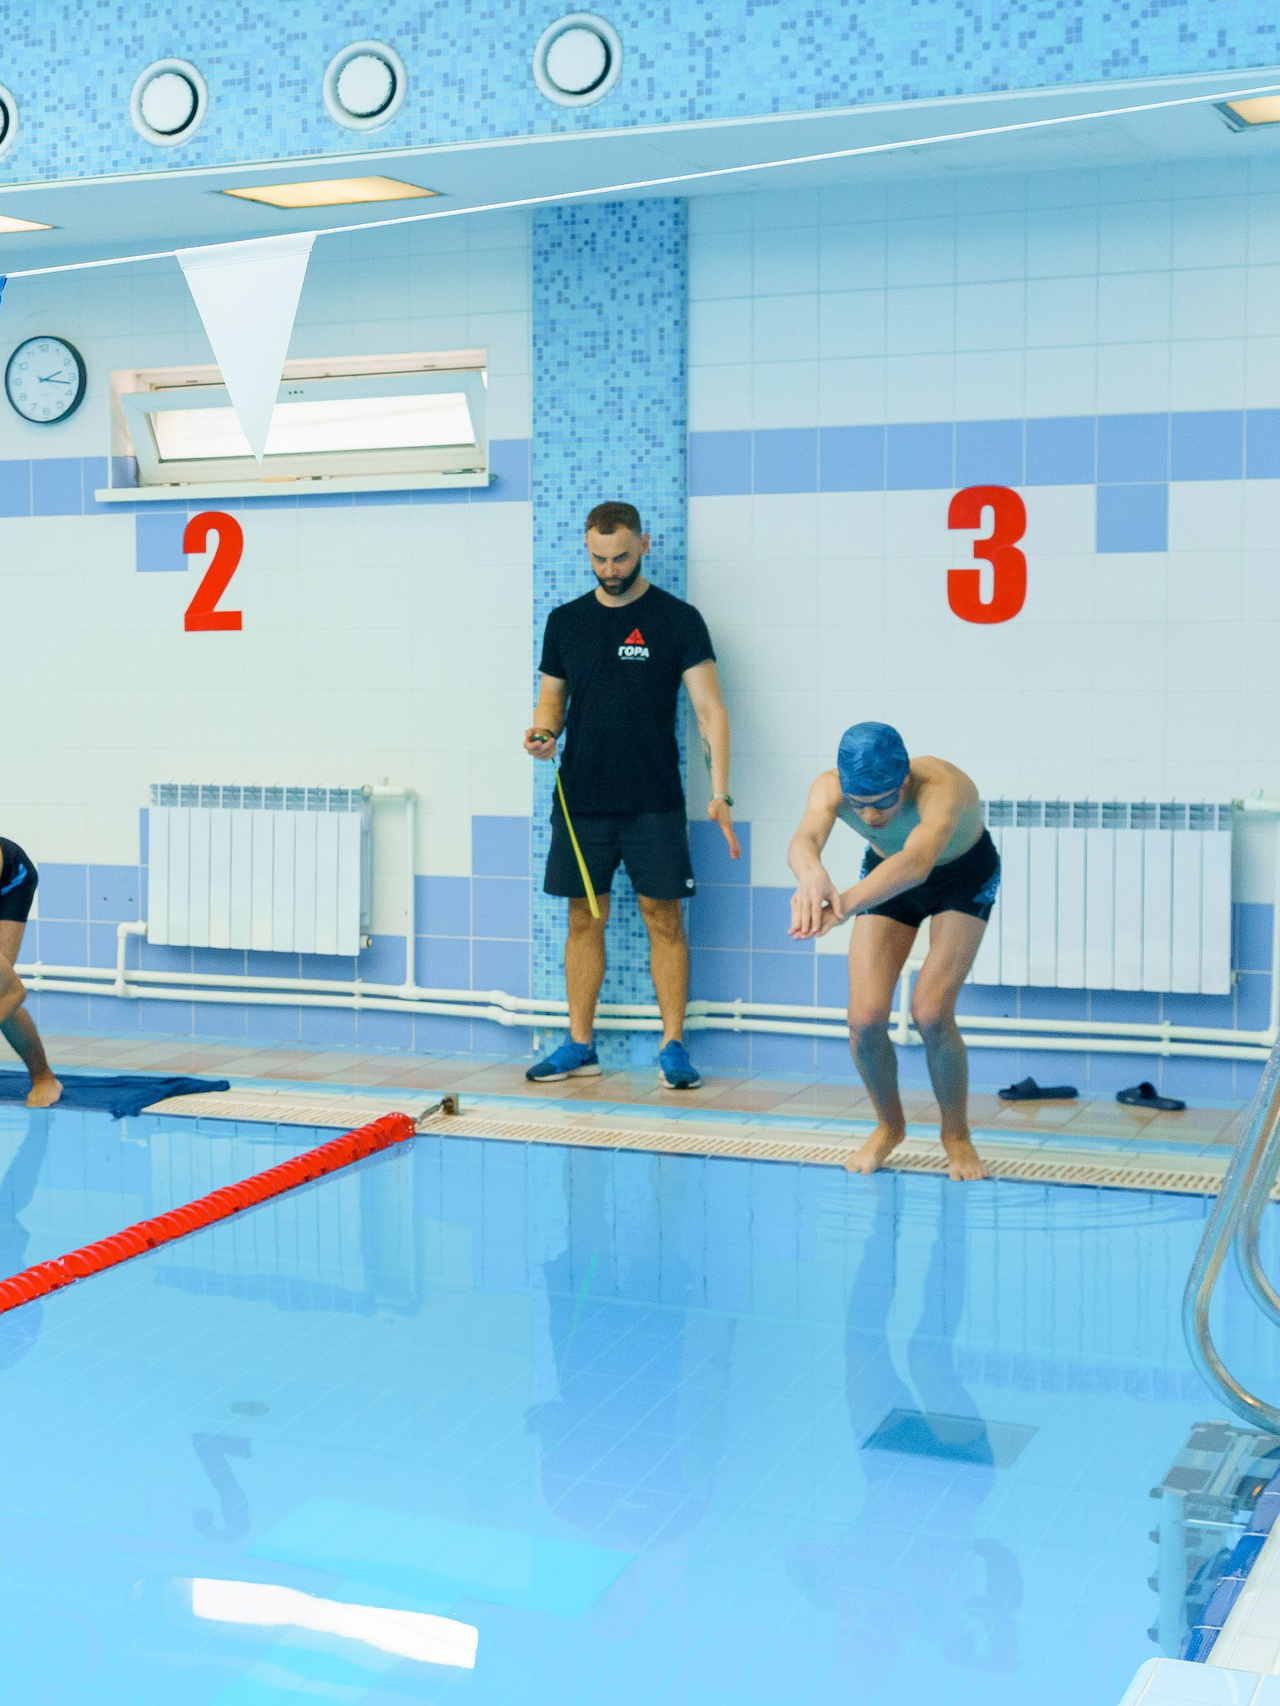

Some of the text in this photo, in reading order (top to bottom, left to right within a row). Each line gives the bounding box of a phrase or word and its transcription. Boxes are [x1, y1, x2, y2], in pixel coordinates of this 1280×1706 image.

[183, 511, 244, 632] 2
[947, 485, 1027, 625] 3
[617, 645, 650, 658] ГОРА
